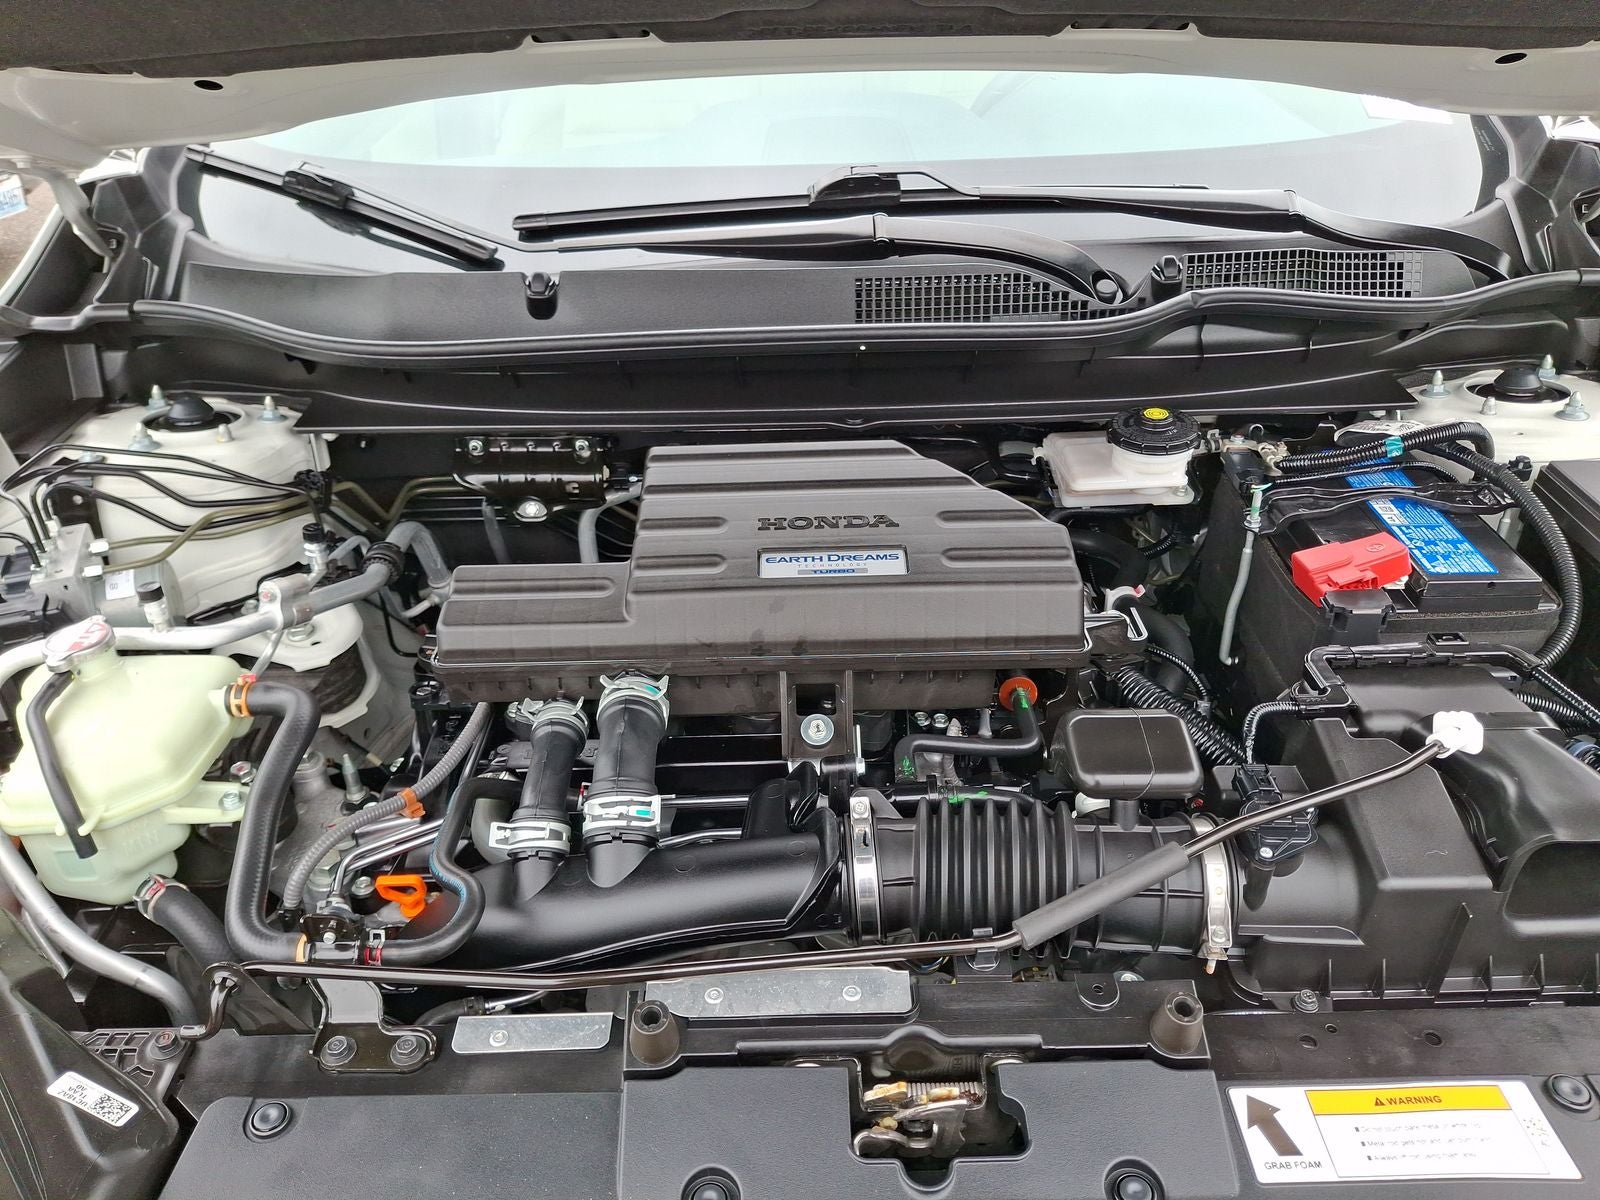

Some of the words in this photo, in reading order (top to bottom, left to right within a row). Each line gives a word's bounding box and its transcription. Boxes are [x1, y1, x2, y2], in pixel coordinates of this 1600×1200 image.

[757, 514, 900, 531] HONDA
[765, 555, 823, 564] EARTH
[827, 553, 900, 562] DREAMS
[1385, 1095, 1442, 1106] WARNING
[1264, 1161, 1292, 1170] GRAB
[1294, 1160, 1323, 1169] FOAM
